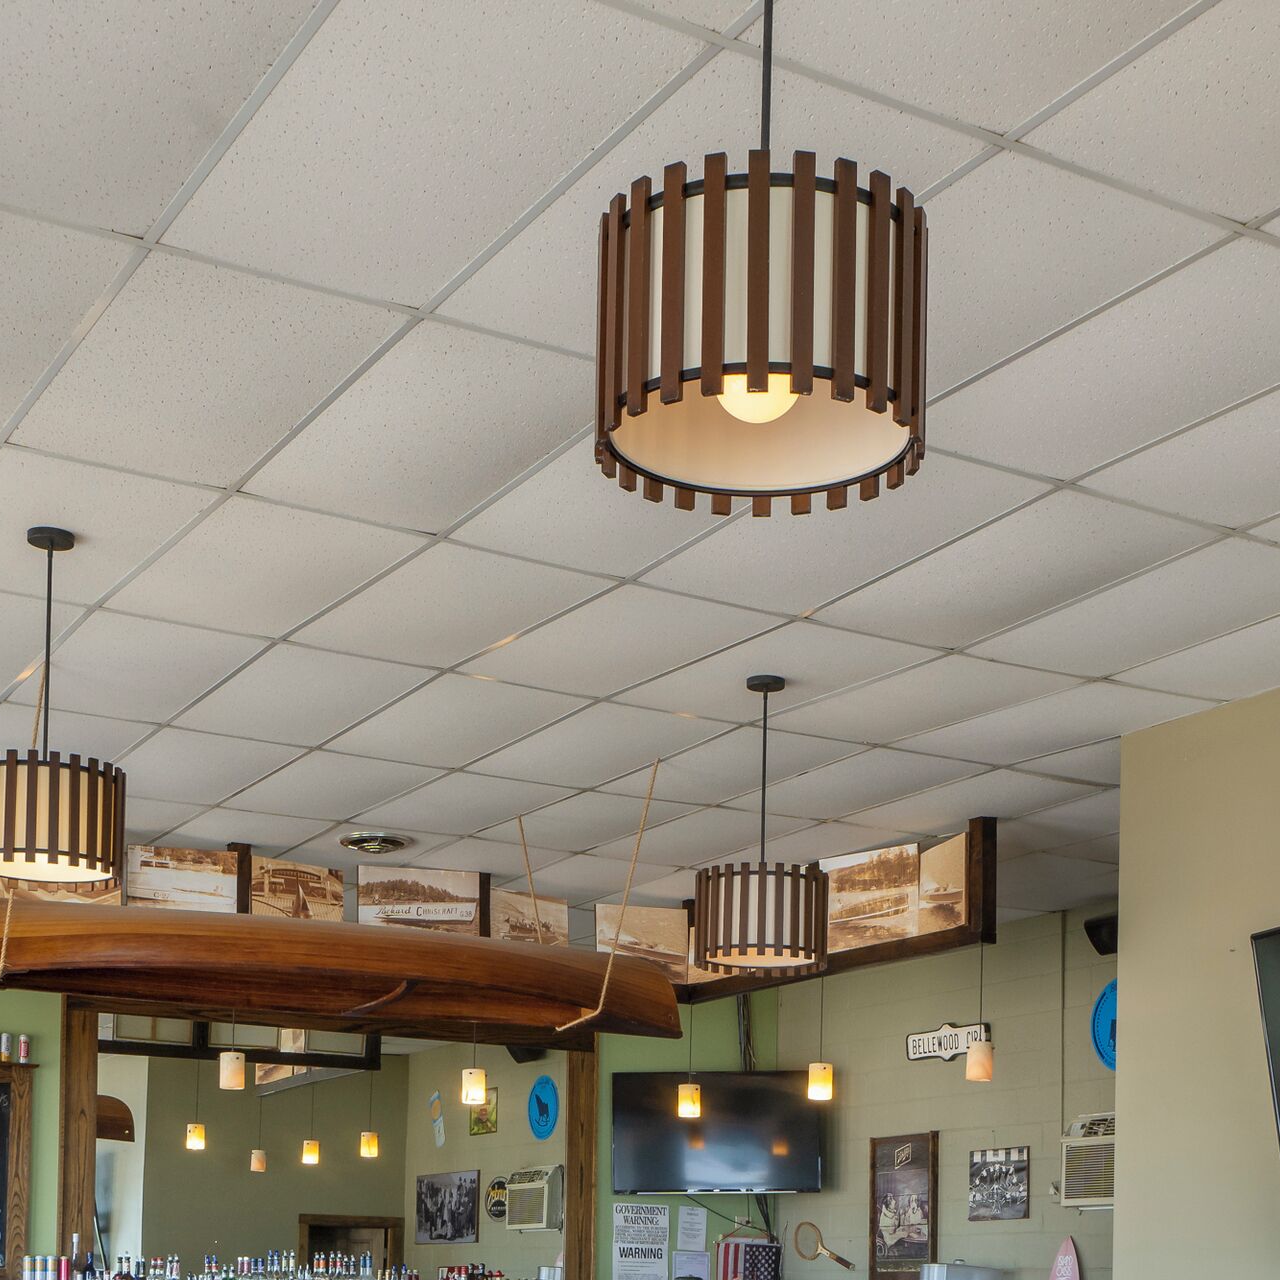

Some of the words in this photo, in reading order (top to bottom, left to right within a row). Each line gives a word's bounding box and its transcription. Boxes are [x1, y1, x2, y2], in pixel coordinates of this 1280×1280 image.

[912, 1033, 960, 1055] BELLEWOOD
[615, 1204, 668, 1217] GOVERNMENT
[618, 1246, 663, 1260] WARNING
